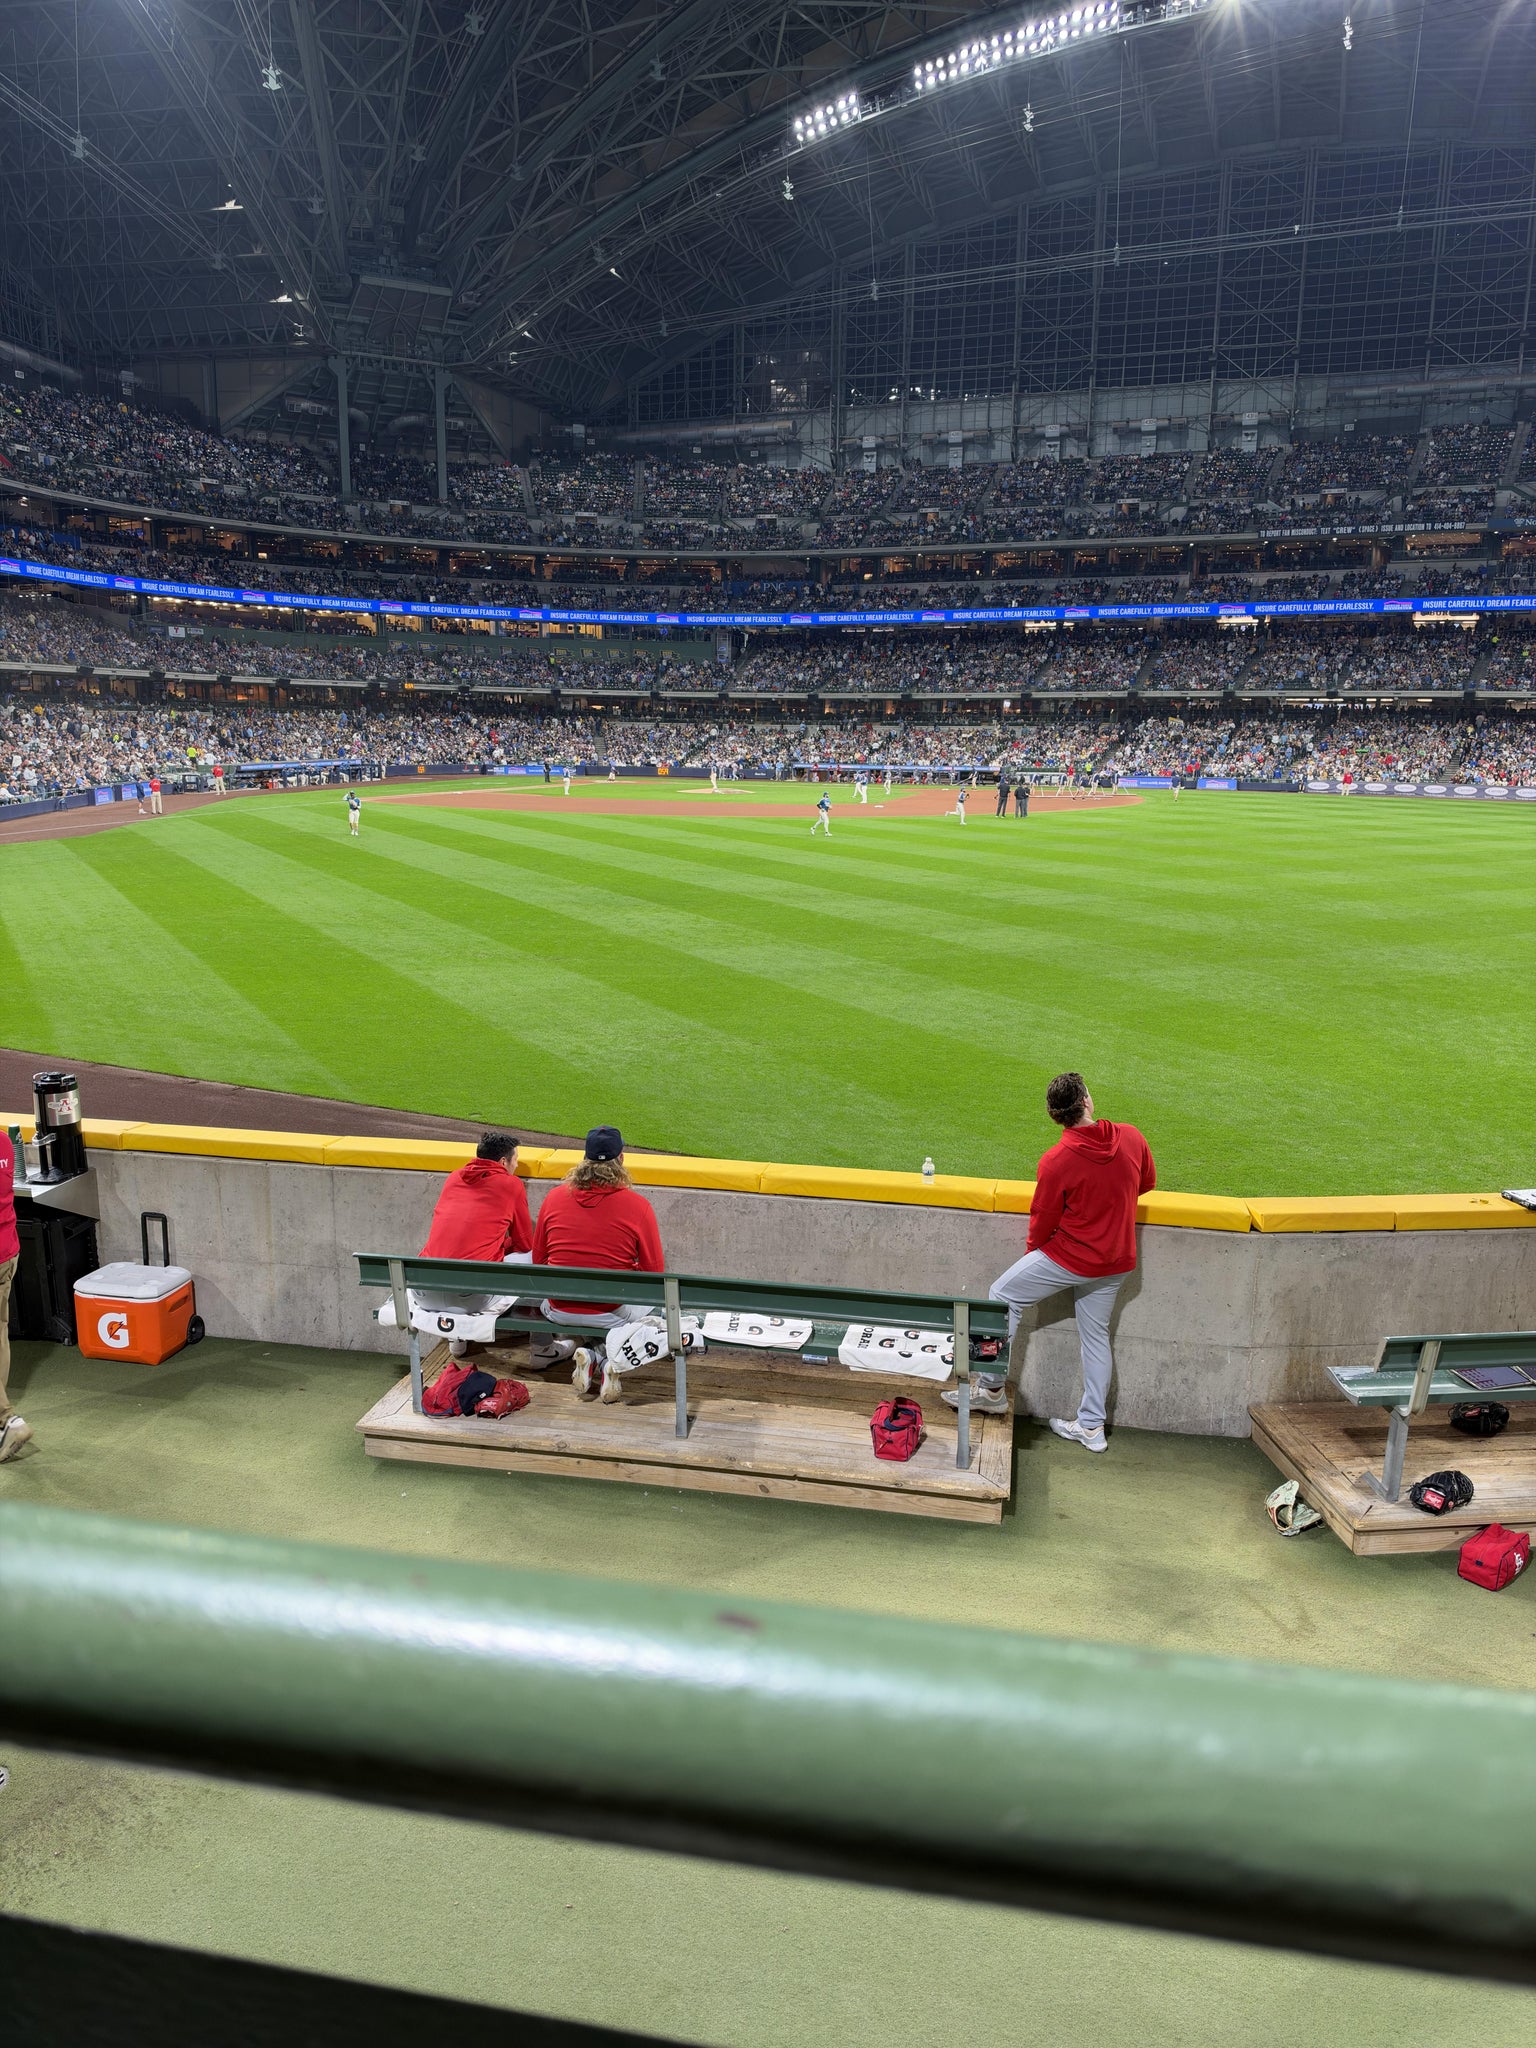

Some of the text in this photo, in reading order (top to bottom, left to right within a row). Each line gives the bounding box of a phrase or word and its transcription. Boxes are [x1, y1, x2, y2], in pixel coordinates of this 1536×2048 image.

[26, 565, 41, 576] INSURE
[66, 571, 80, 581] DREAM
[141, 582, 158, 591] INSURE
[187, 586, 205, 596] DREAM
[273, 595, 292, 604] INSURE
[322, 598, 340, 607] DREAM
[1423, 601, 1447, 609] INSURE
[1486, 599, 1510, 607] DREAM
[410, 604, 430, 613] INSURE
[460, 607, 479, 615] DREAM
[1153, 607, 1174, 615] DREAM
[1313, 603, 1335, 611] DREAM
[550, 612, 569, 620] INSURE
[599, 613, 618, 621] DREAM
[686, 615, 705, 623] INSURE
[865, 613, 883, 621] DREAM
[1003, 610, 1022, 618] DREAM
[98, 1312, 130, 1349] G
[904, 1330, 921, 1340] G
[879, 1338, 897, 1348] G
[622, 1338, 641, 1367] ATO
[921, 1344, 938, 1353] G
